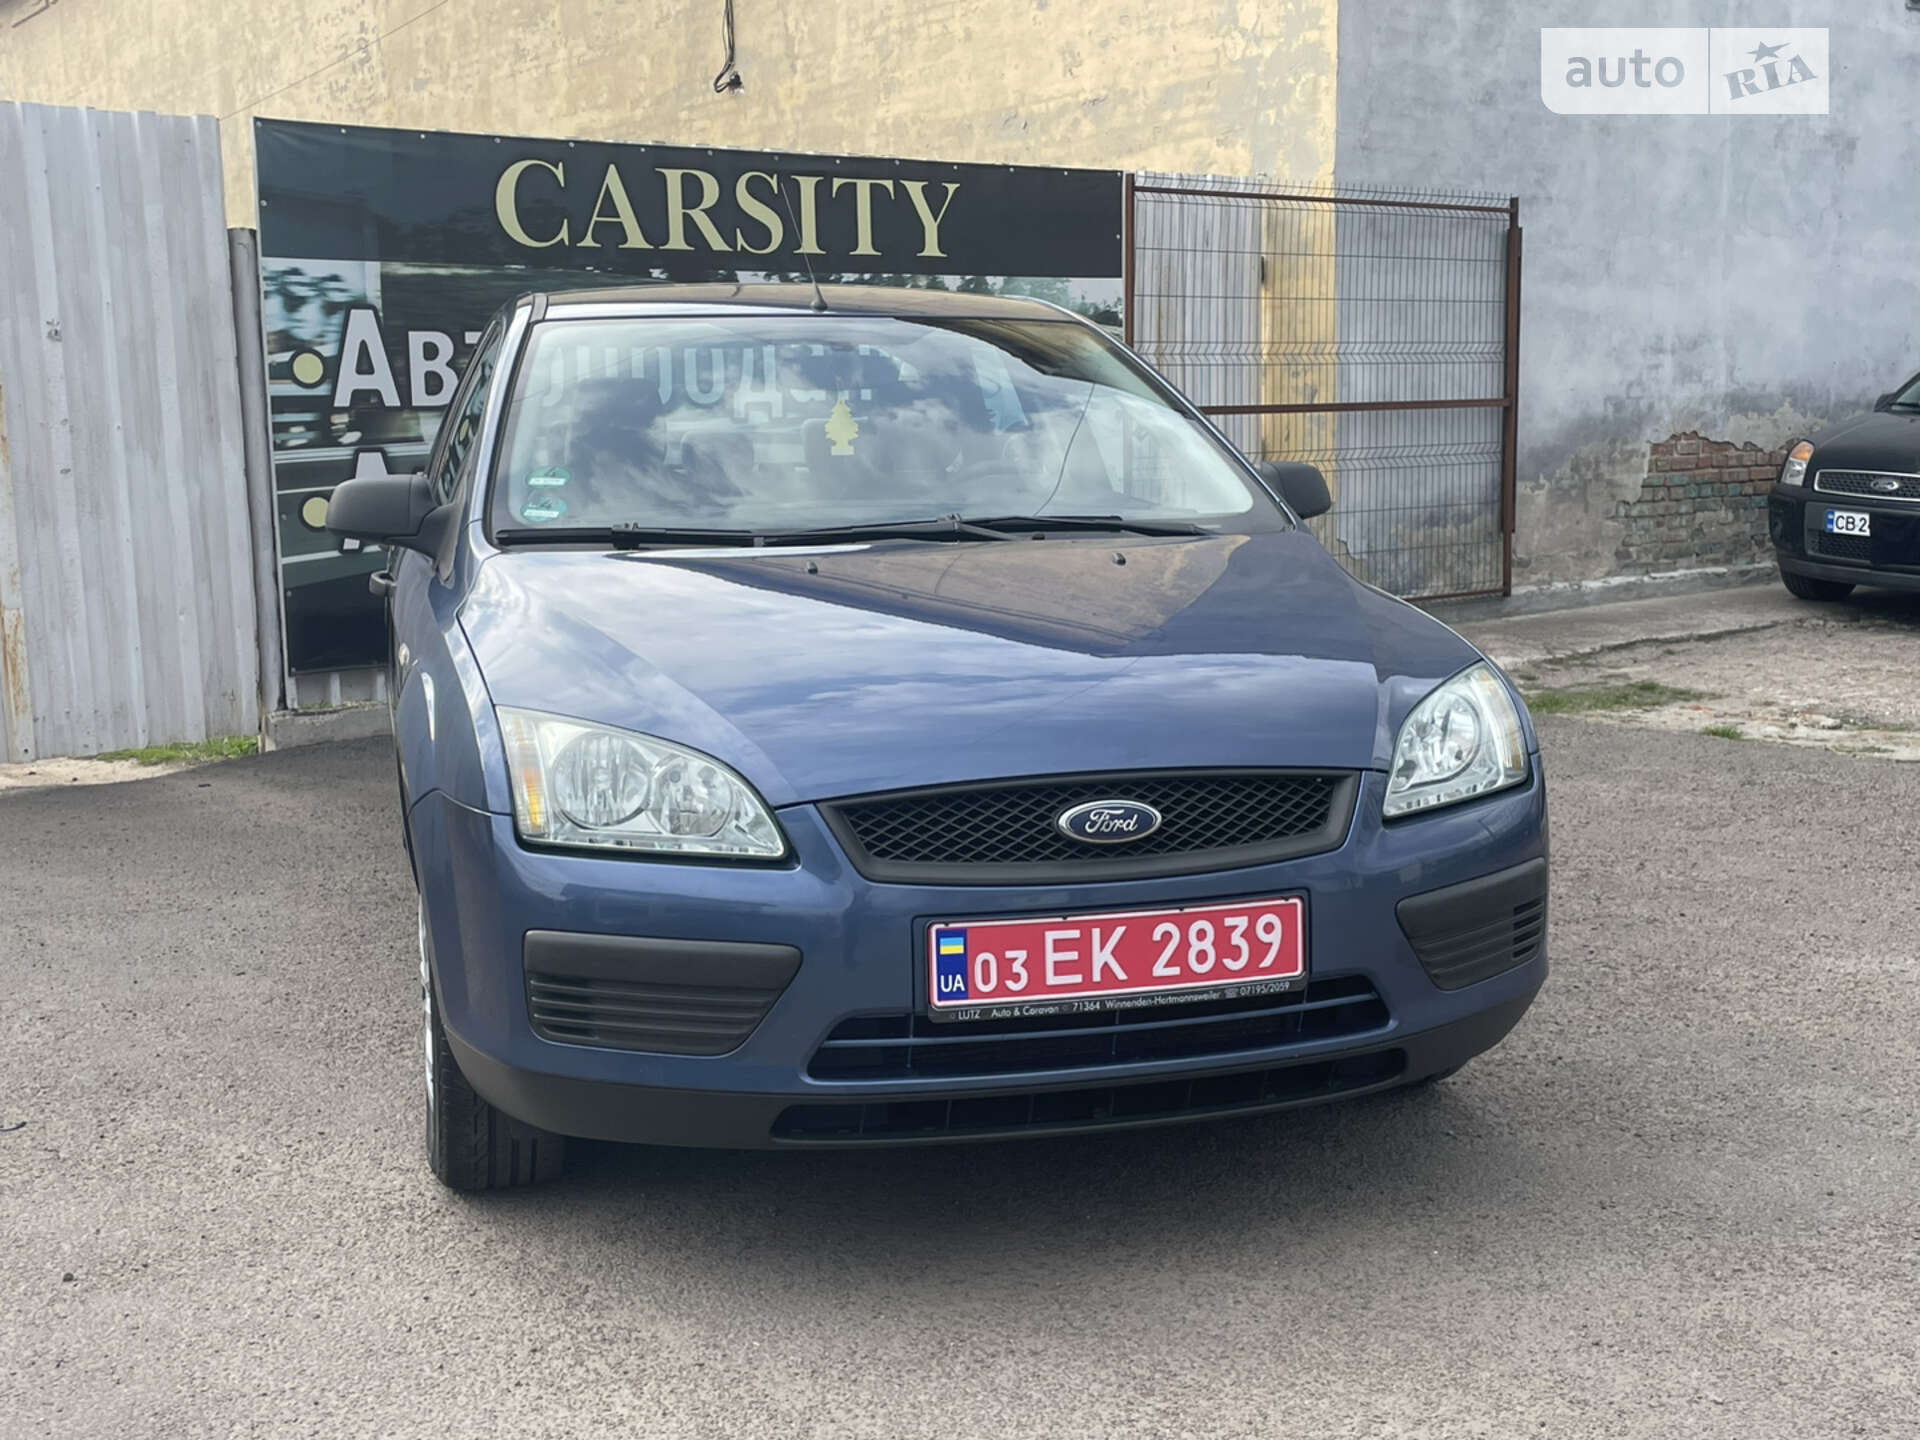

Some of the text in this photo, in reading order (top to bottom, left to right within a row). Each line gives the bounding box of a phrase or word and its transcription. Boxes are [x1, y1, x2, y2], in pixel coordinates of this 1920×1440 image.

[494, 158, 961, 258] CARSITY
[333, 309, 483, 408] АВ
[1085, 809, 1138, 833] Ford
[940, 913, 1282, 993] UA 03 EK 2839
[958, 1010, 981, 1020] LUTZ
[991, 1008, 1011, 1018] Auto
[1013, 1006, 1020, 1016] &
[1023, 1005, 1060, 1017] Caravan
[1072, 1001, 1101, 1012] 71364
